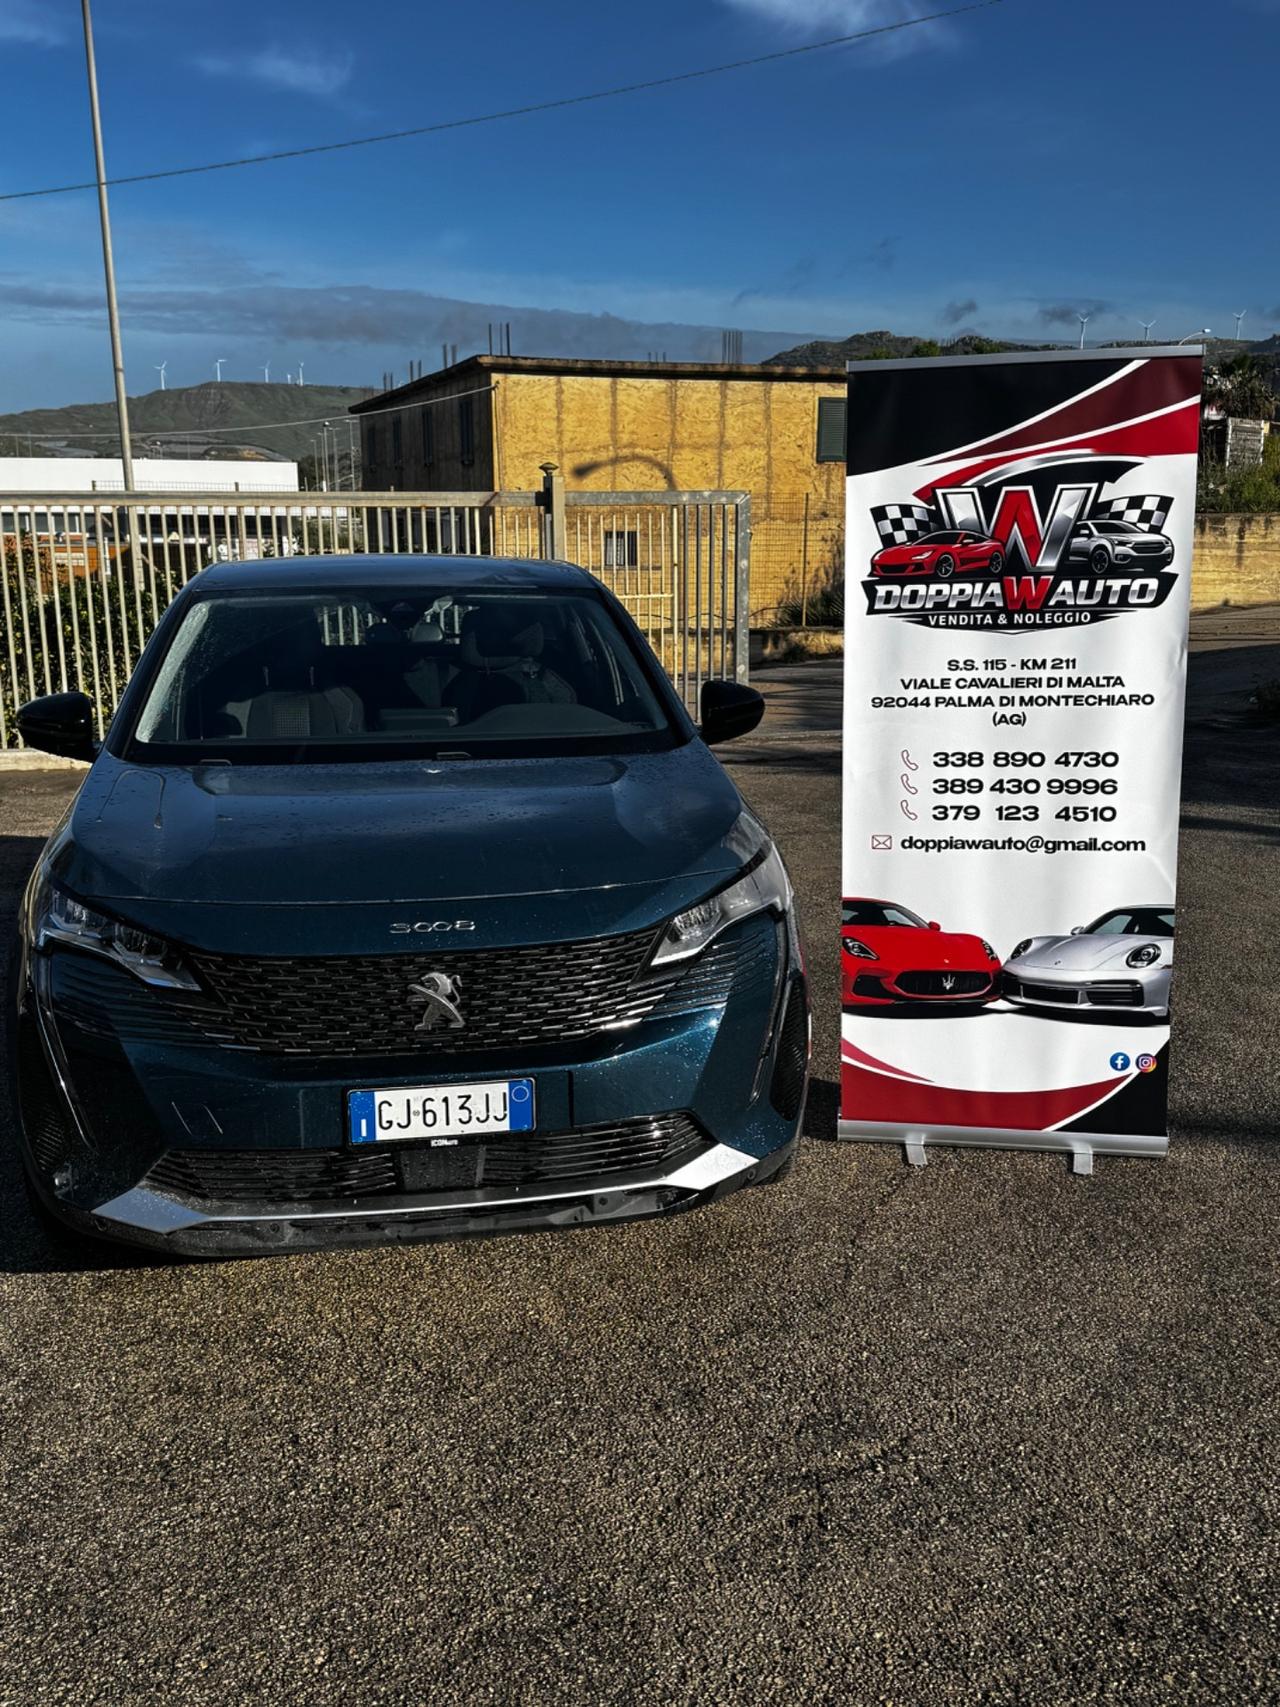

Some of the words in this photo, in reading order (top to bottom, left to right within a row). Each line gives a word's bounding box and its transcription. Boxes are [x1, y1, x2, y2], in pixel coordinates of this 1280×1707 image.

[928, 614, 993, 626] VENDITA
[998, 613, 1008, 625] &
[1014, 611, 1091, 624] NOLEGGIO
[947, 659, 979, 672] S.S.
[983, 658, 1007, 671] 115
[1020, 658, 1047, 671] KM
[1050, 657, 1077, 670] 211
[901, 678, 951, 690] VIALE
[955, 676, 1043, 690] CAVALIERI
[1047, 676, 1063, 689] DI
[1067, 675, 1126, 689] MALTA
[871, 696, 931, 709] 92044
[934, 695, 995, 708] PALMA
[999, 695, 1016, 708] DI
[1019, 693, 1155, 707] MONTECHIARO
[992, 711, 1027, 727] (AG)
[932, 751, 985, 768] 338
[993, 751, 1046, 768] 890
[1054, 751, 1120, 768] 4730
[932, 778, 984, 795] 389
[989, 778, 1041, 795] 430
[1046, 778, 1118, 795] 9996
[932, 804, 981, 821] 379
[995, 805, 1040, 821] 123
[1054, 806, 1117, 823] 4510
[900, 835, 1146, 855] doppiawauto@gmail.com
[390, 920, 476, 934] 3008
